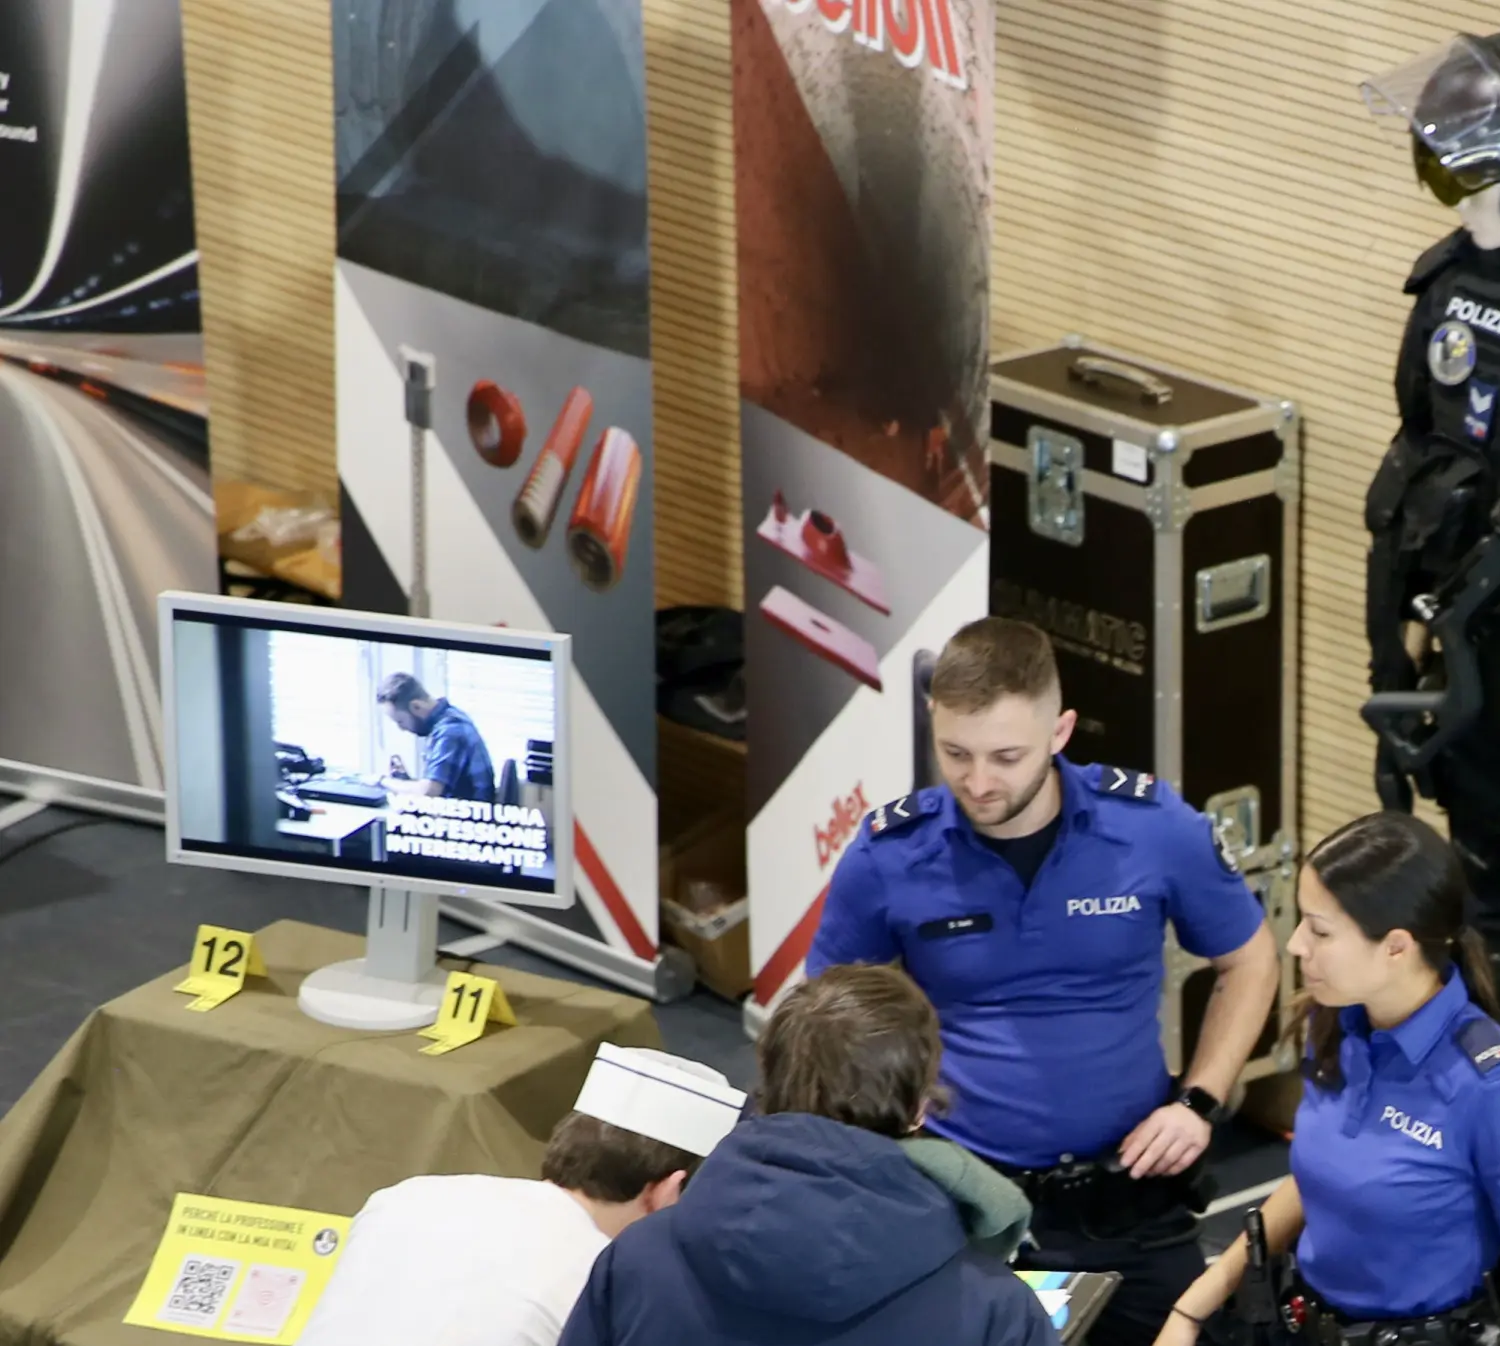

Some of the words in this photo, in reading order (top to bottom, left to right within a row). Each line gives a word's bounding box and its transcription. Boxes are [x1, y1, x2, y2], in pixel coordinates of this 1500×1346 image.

[386, 792, 492, 822] VORRESTI
[494, 802, 546, 828] UNA
[386, 812, 547, 850] PROFESSIONE
[386, 833, 548, 869] INTERESSANTE?
[1066, 895, 1142, 917] POLIZIA
[201, 936, 245, 978] 12
[451, 983, 484, 1024] 11
[1379, 1104, 1443, 1151] POLIZIA
